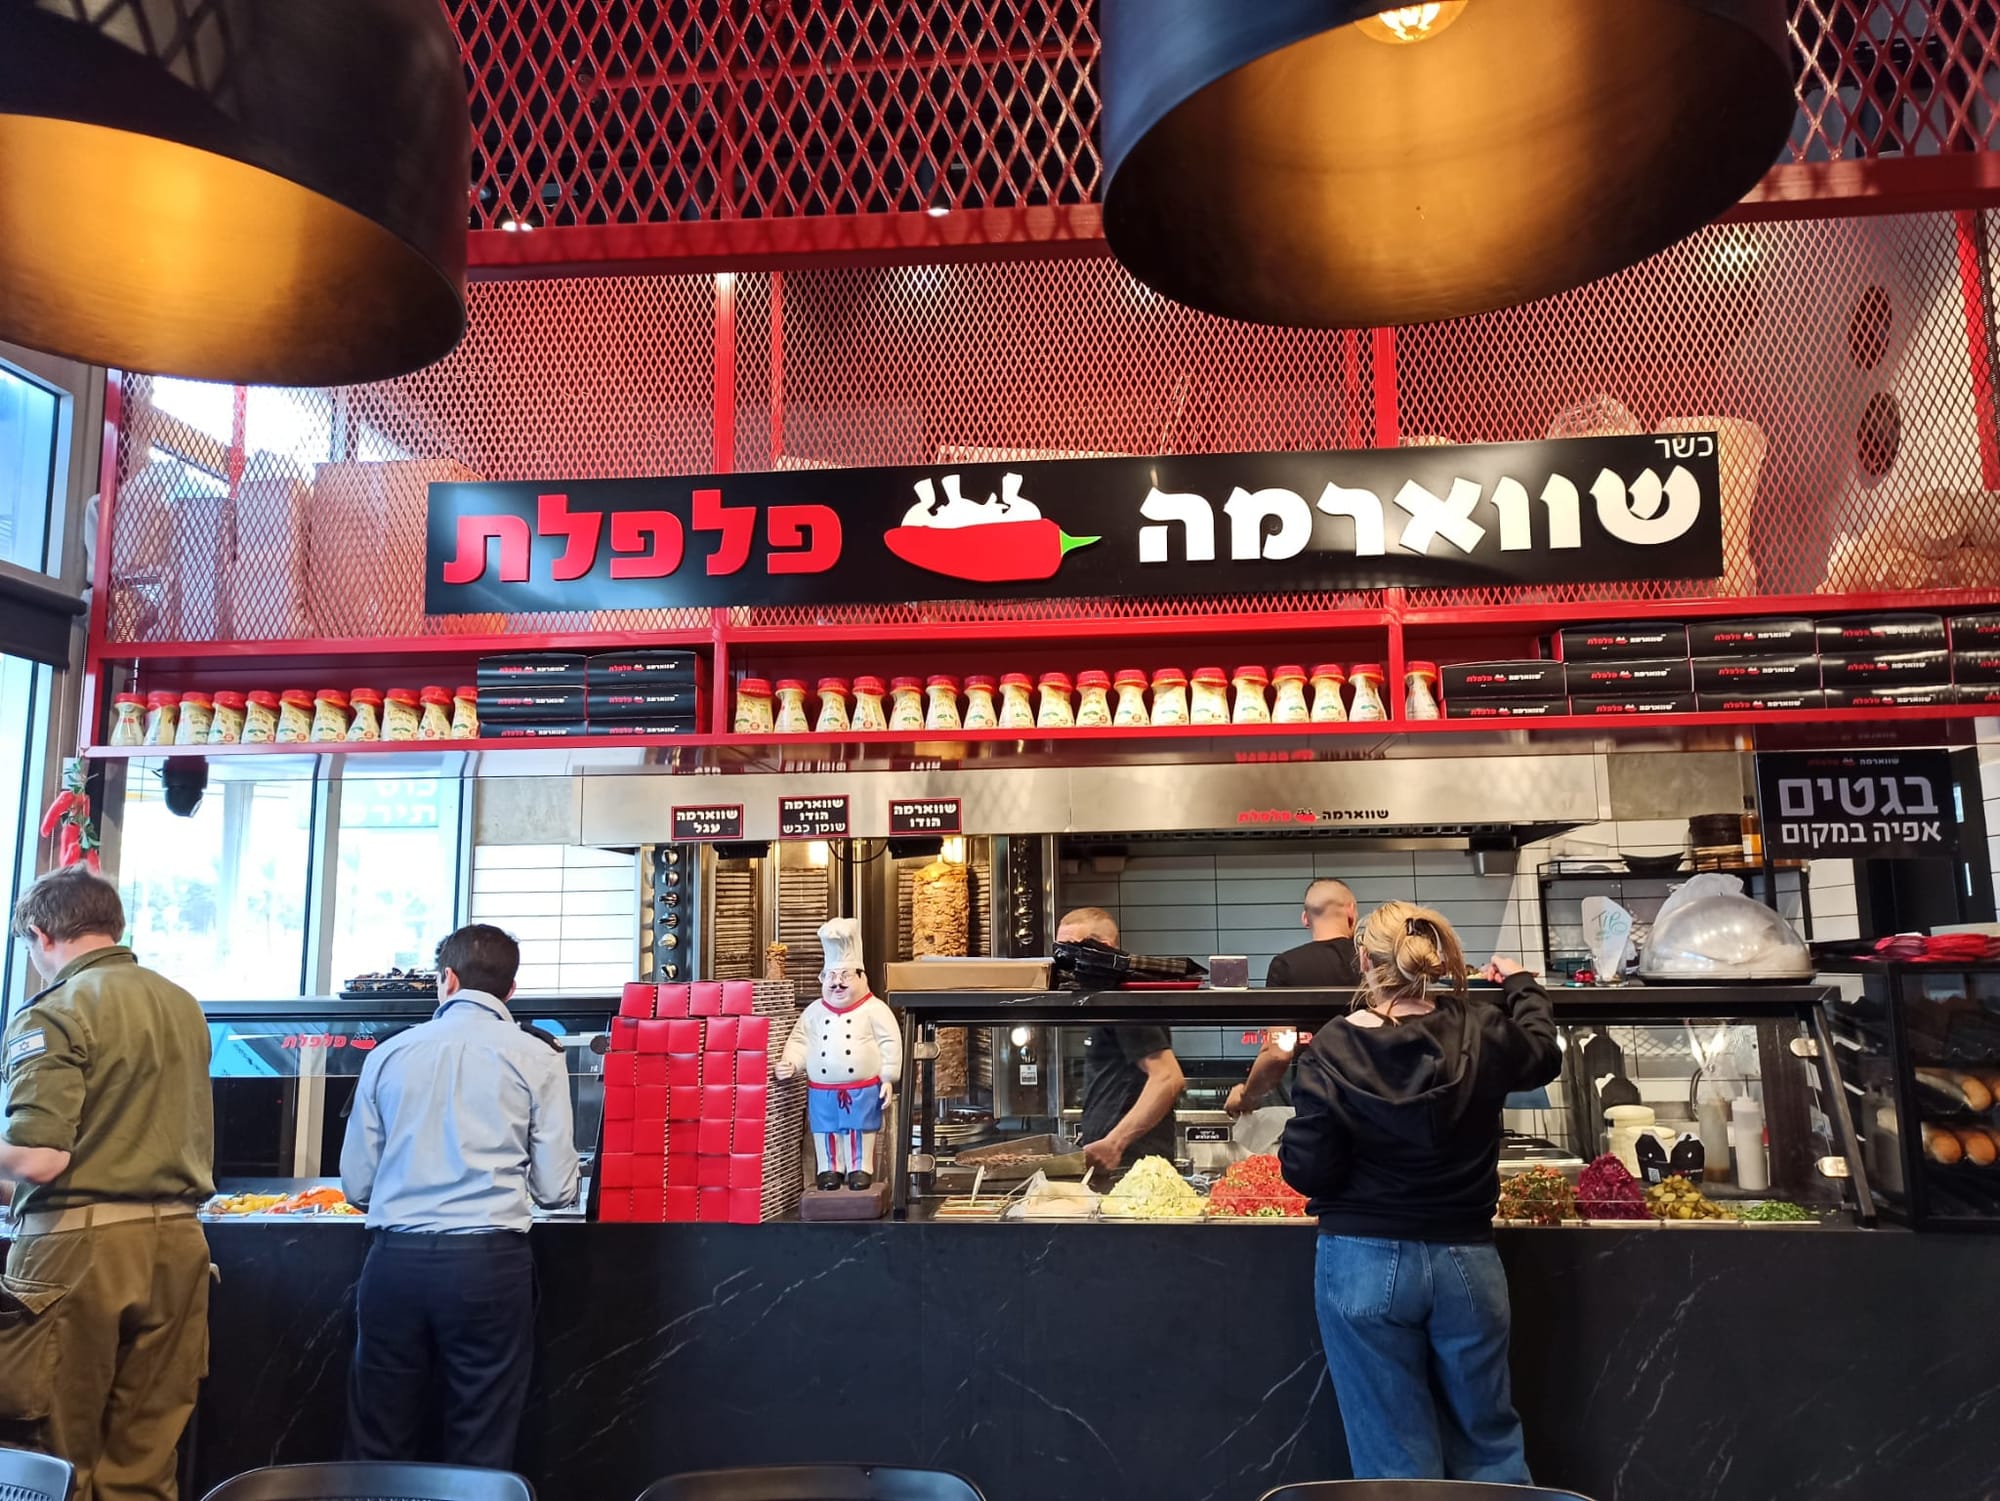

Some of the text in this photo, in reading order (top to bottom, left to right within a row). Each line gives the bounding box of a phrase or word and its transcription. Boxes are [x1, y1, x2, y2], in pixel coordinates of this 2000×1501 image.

[1655, 436, 1713, 459] כשר
[443, 465, 1700, 584] שווארמה פלפלת
[1778, 776, 1939, 817] בגטים
[784, 798, 844, 810] שווארמה
[894, 803, 957, 815] שווארמה
[676, 809, 738, 821] שווארמה
[800, 811, 829, 821] הודו
[1322, 810, 1389, 820] שווארמה
[693, 822, 721, 834] עגל
[783, 822, 846, 835] שומן כבש
[909, 817, 941, 828] הודו
[1782, 821, 1942, 849] אפיה במקום
[281, 1033, 348, 1049] פלפלת
